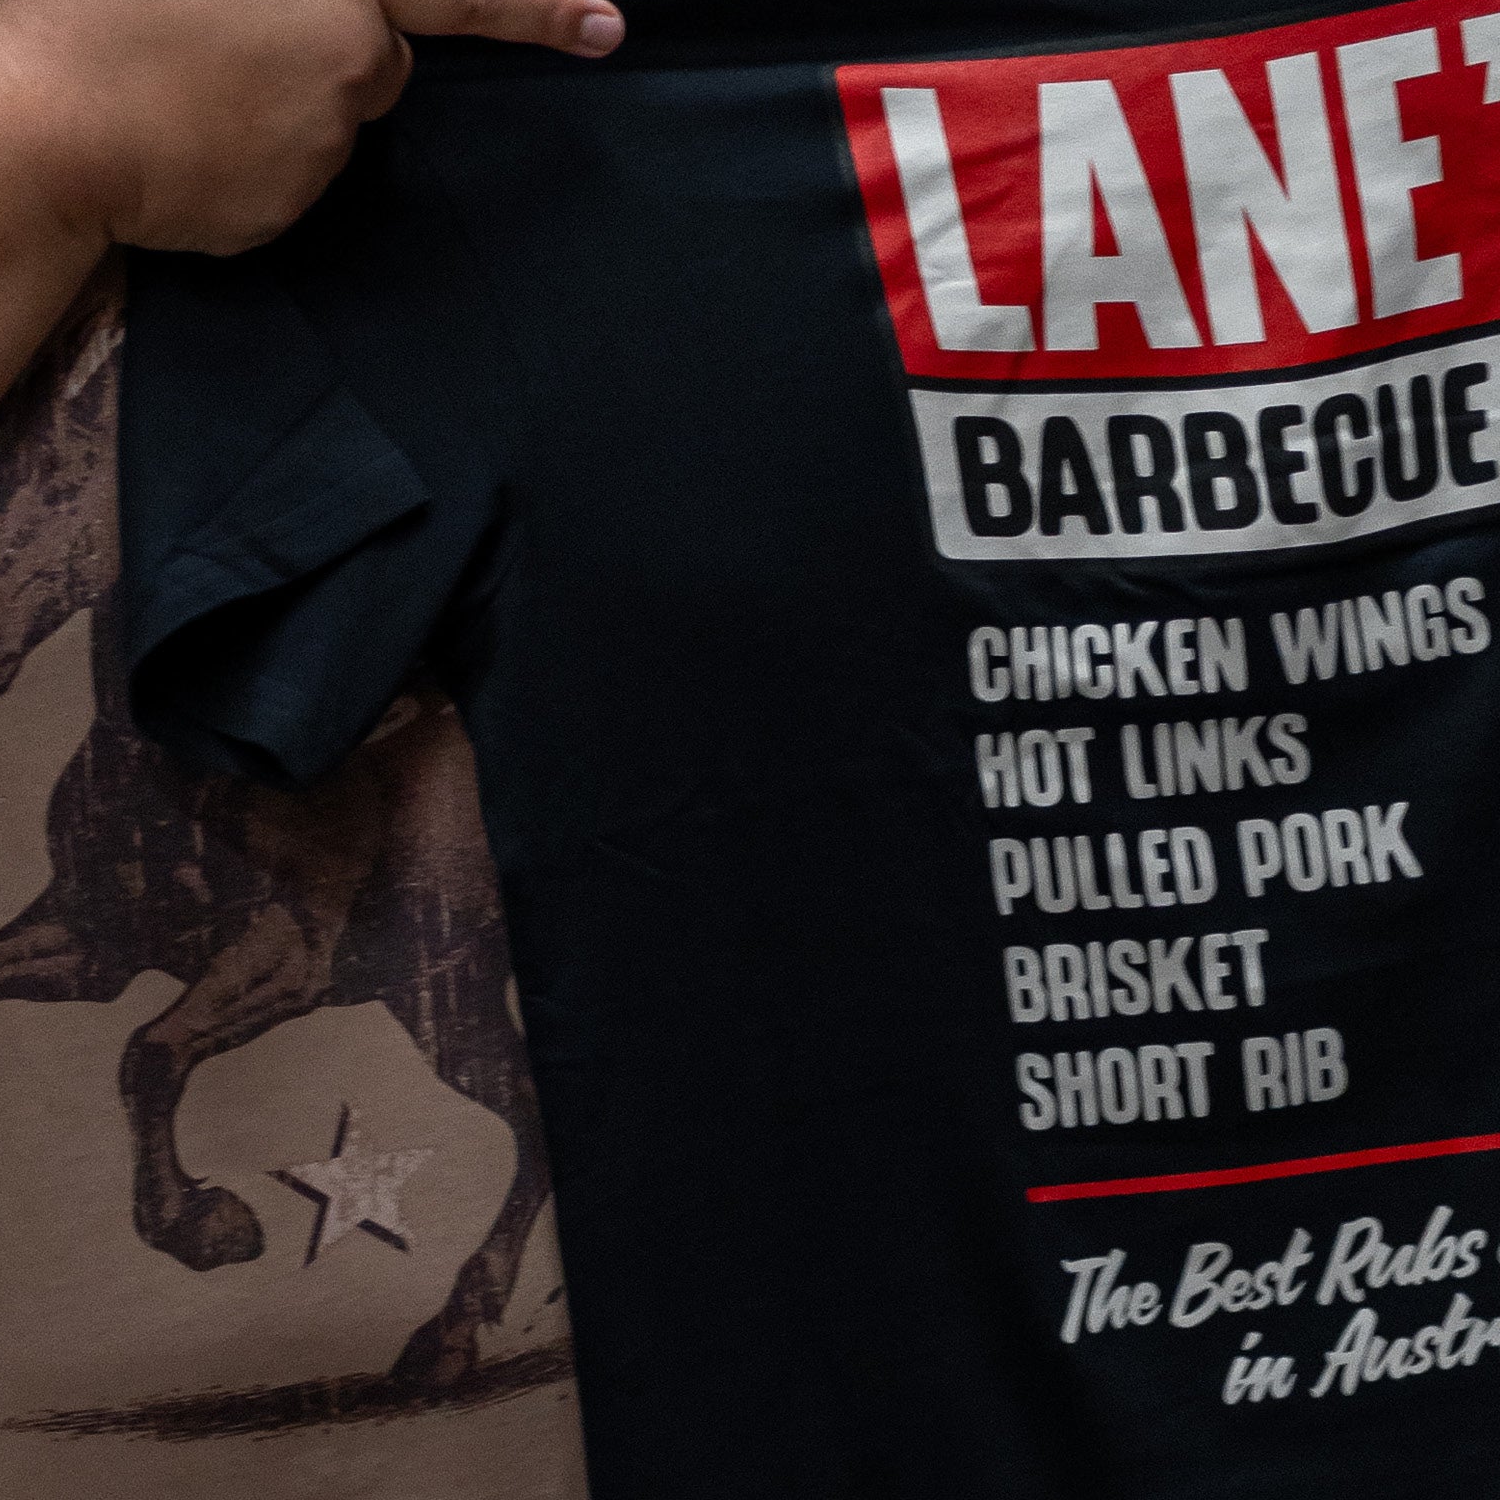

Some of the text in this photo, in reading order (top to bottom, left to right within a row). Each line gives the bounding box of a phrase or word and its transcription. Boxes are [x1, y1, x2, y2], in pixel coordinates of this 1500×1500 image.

[951, 362, 1499, 540] BARBECUE
[969, 617, 1247, 702] CHICKEN
[1272, 577, 1490, 684] WINGS
[977, 727, 1093, 808] HOT
[1123, 714, 1309, 799] LINKS
[990, 826, 1216, 915] PULLED
[1238, 801, 1422, 897] PORK
[1005, 929, 1268, 1023] BRISKET
[1018, 1042, 1214, 1130] SHORT
[1243, 1028, 1346, 1111] RIB
[1061, 1249, 1161, 1343] The
[1170, 1228, 1313, 1328] Best
[1317, 1205, 1486, 1305] Rubs
[1223, 1332, 1296, 1404] in
